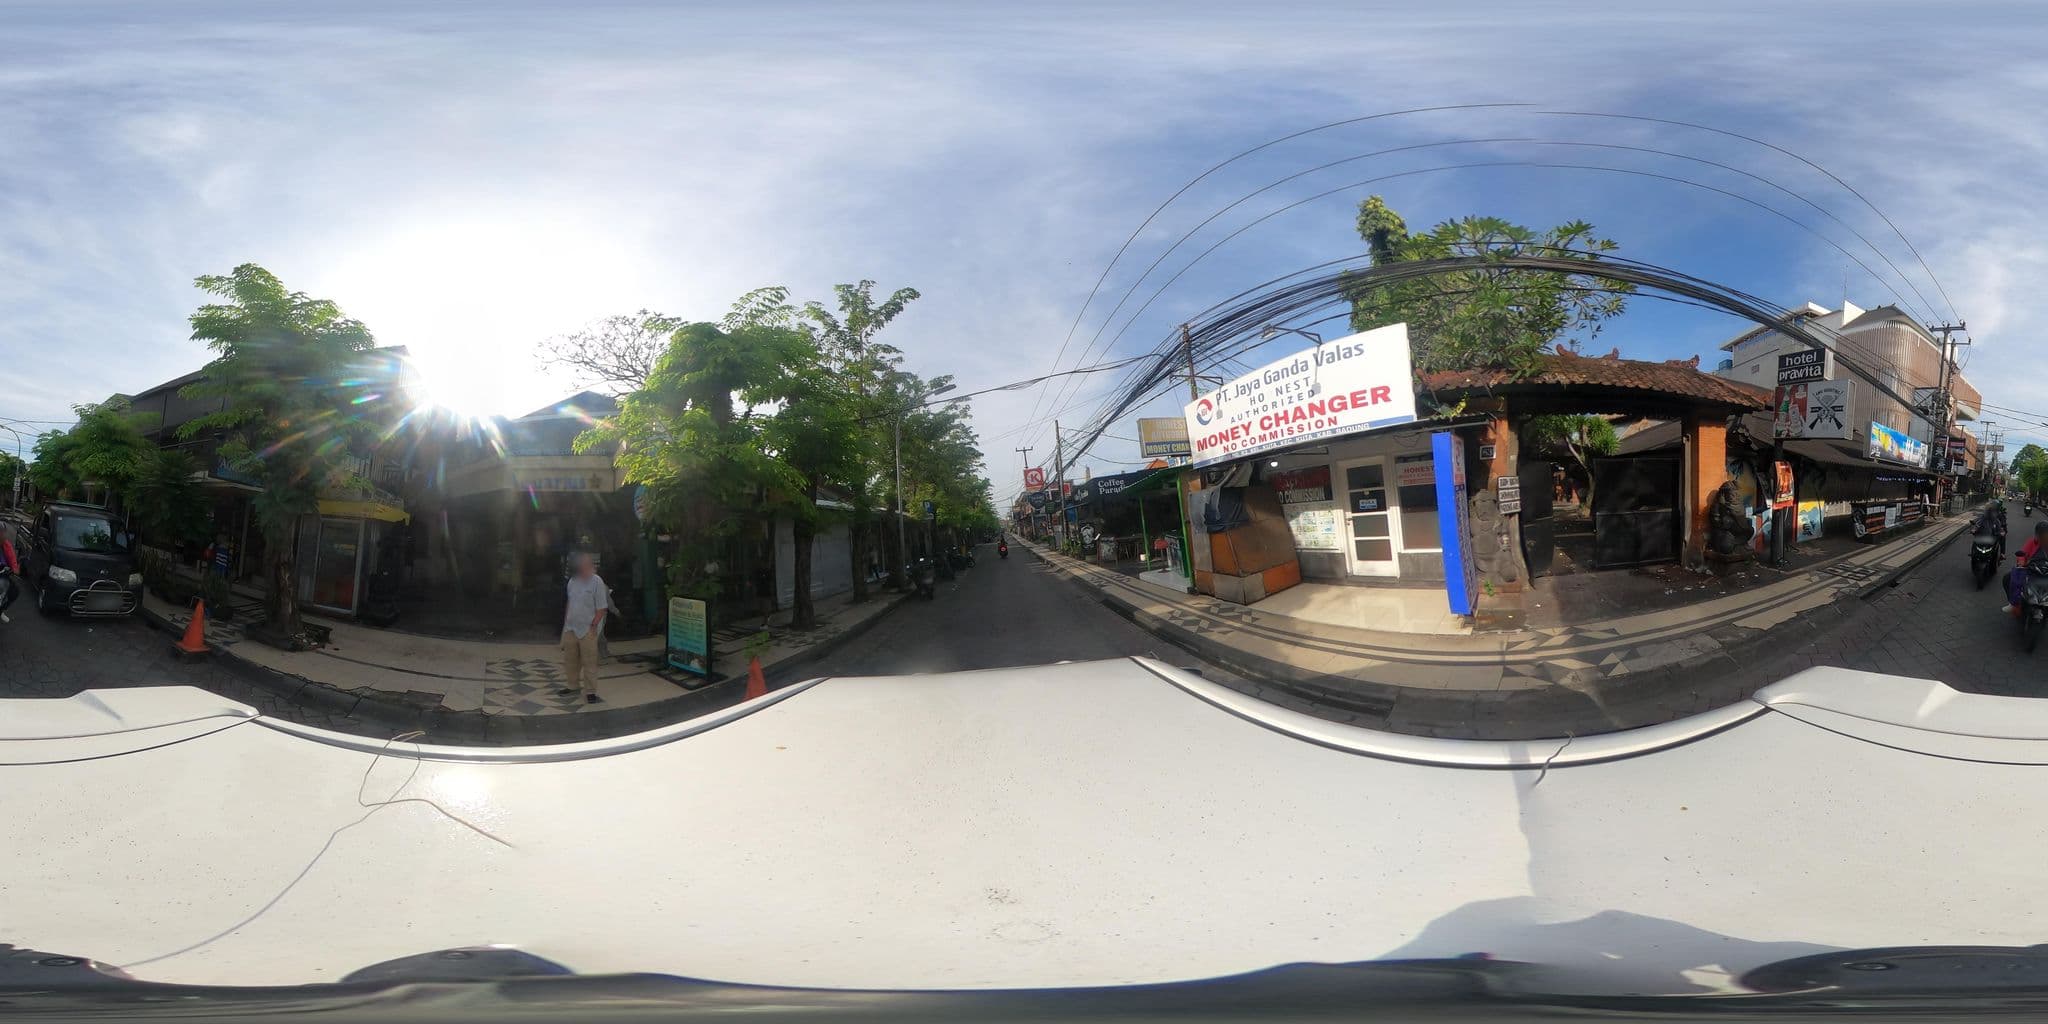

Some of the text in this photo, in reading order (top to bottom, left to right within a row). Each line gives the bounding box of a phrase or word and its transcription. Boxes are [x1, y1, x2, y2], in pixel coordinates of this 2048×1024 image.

[1785, 352, 1817, 366] hotel
[1216, 343, 1365, 404] PT. Jaya Ganda Valas
[1779, 365, 1822, 381] pravita
[1230, 388, 1315, 425] AUTHORIZED
[1197, 385, 1392, 452] MONEY CHANGER
[1223, 416, 1338, 453] NO COMMISSION
[1146, 443, 1171, 454] MONEY
[1030, 473, 1039, 482] K
[1098, 479, 1124, 488] Coffee
